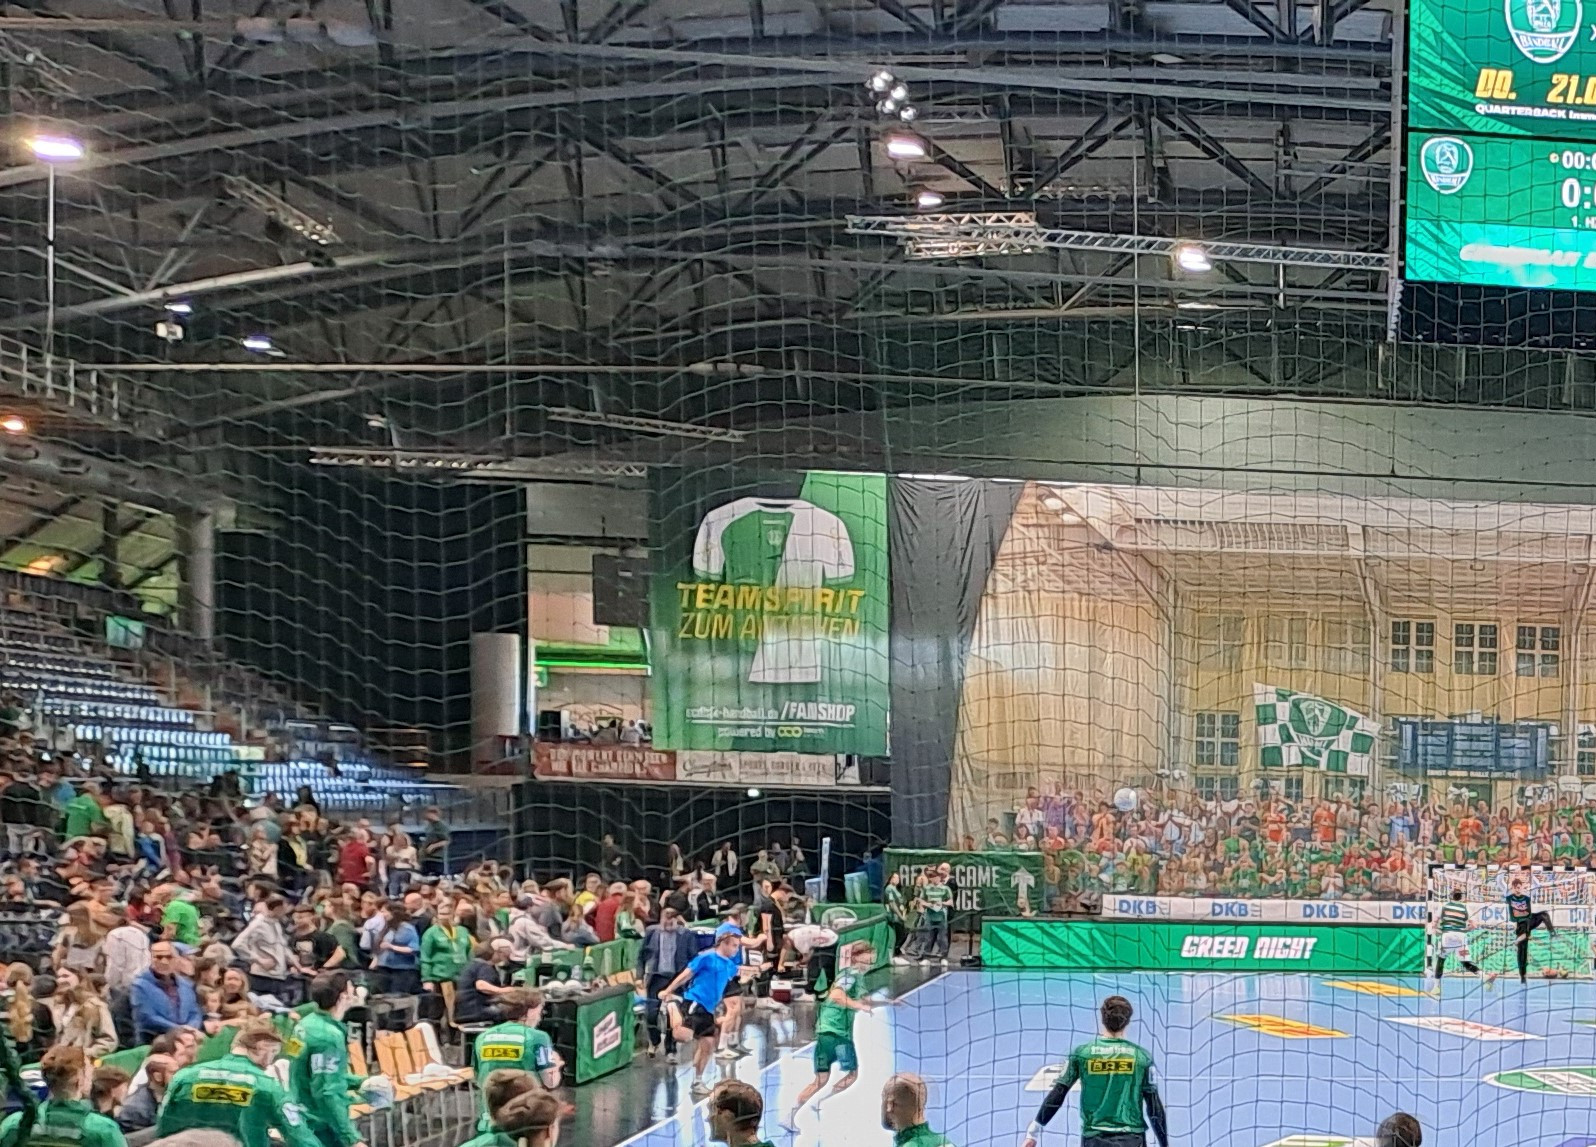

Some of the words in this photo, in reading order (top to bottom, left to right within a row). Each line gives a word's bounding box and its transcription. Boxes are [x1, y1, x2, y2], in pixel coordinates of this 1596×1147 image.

[1475, 103, 1566, 119] QUARTERBACK
[677, 582, 865, 614] TEAMSPIRIT
[678, 612, 733, 640] ZUM
[1118, 899, 1157, 915] DKB
[1211, 902, 1249, 917] DKB
[1302, 903, 1339, 919] DKB
[1253, 936, 1318, 960] NIGHT
